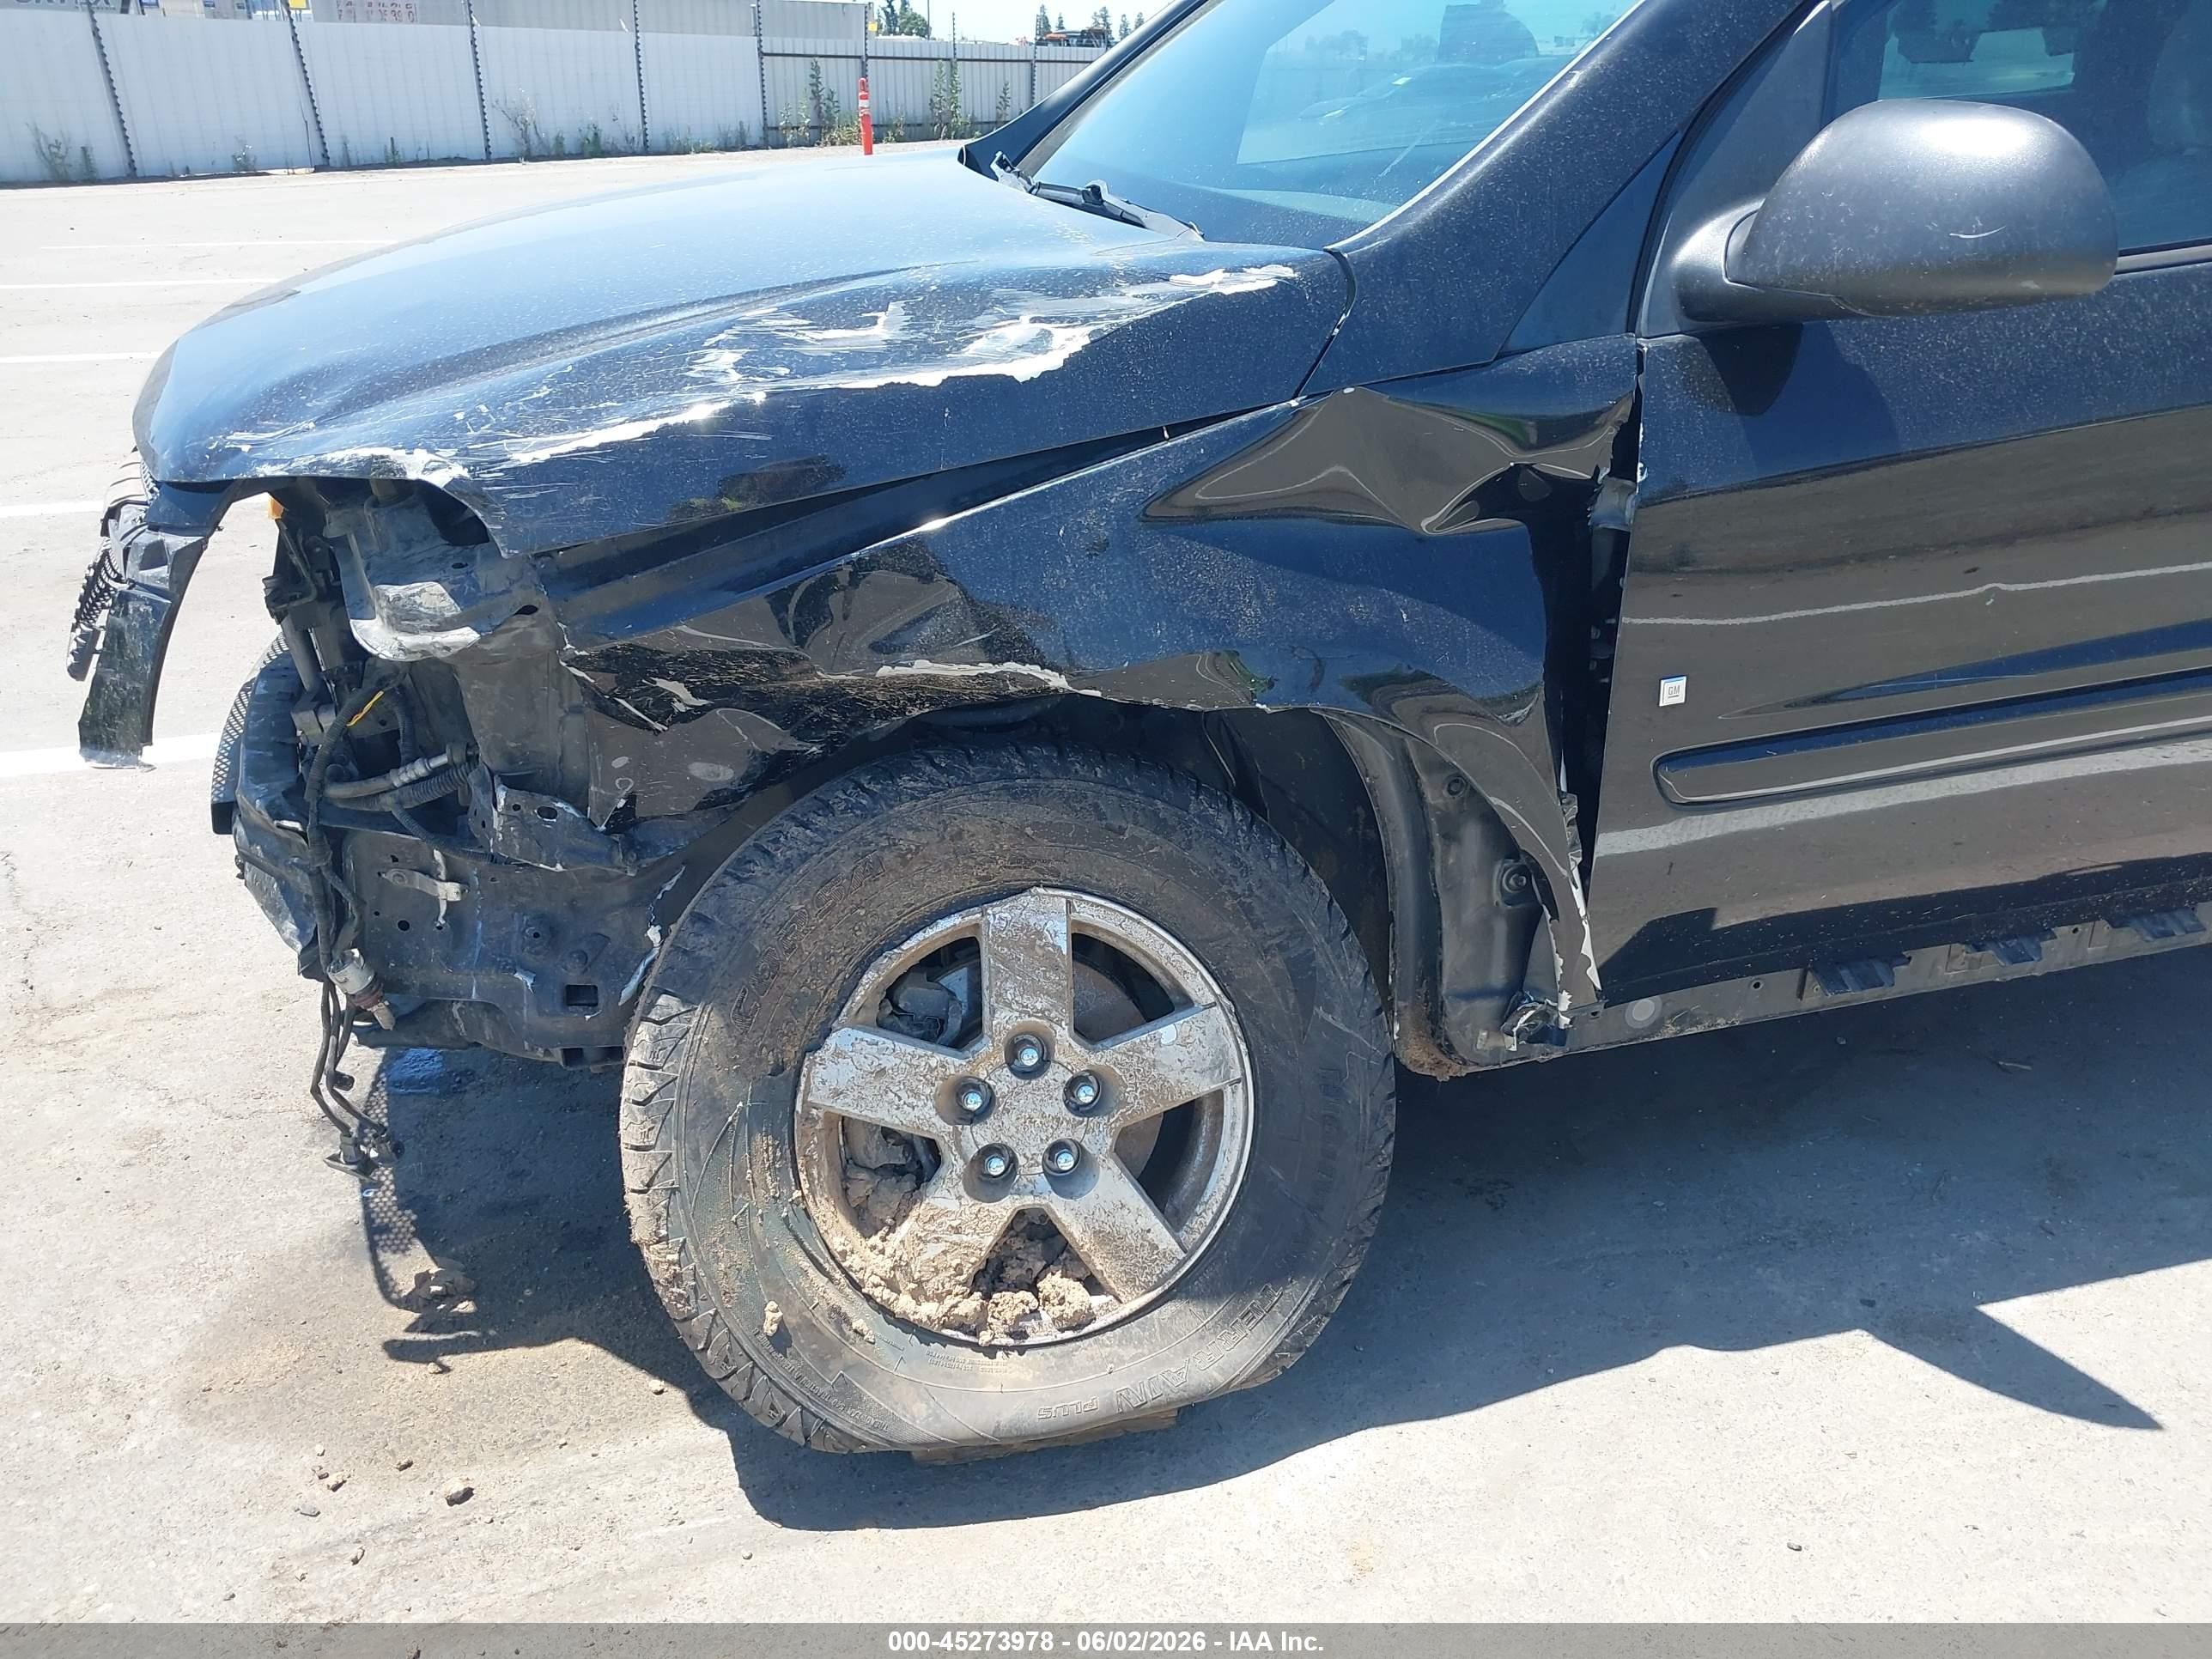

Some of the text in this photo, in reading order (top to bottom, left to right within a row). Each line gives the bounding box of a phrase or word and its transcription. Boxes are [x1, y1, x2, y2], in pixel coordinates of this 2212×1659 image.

[729, 848, 887, 1035] CORSA
[1036, 1284, 1284, 1421] TERRAIN PLUS
